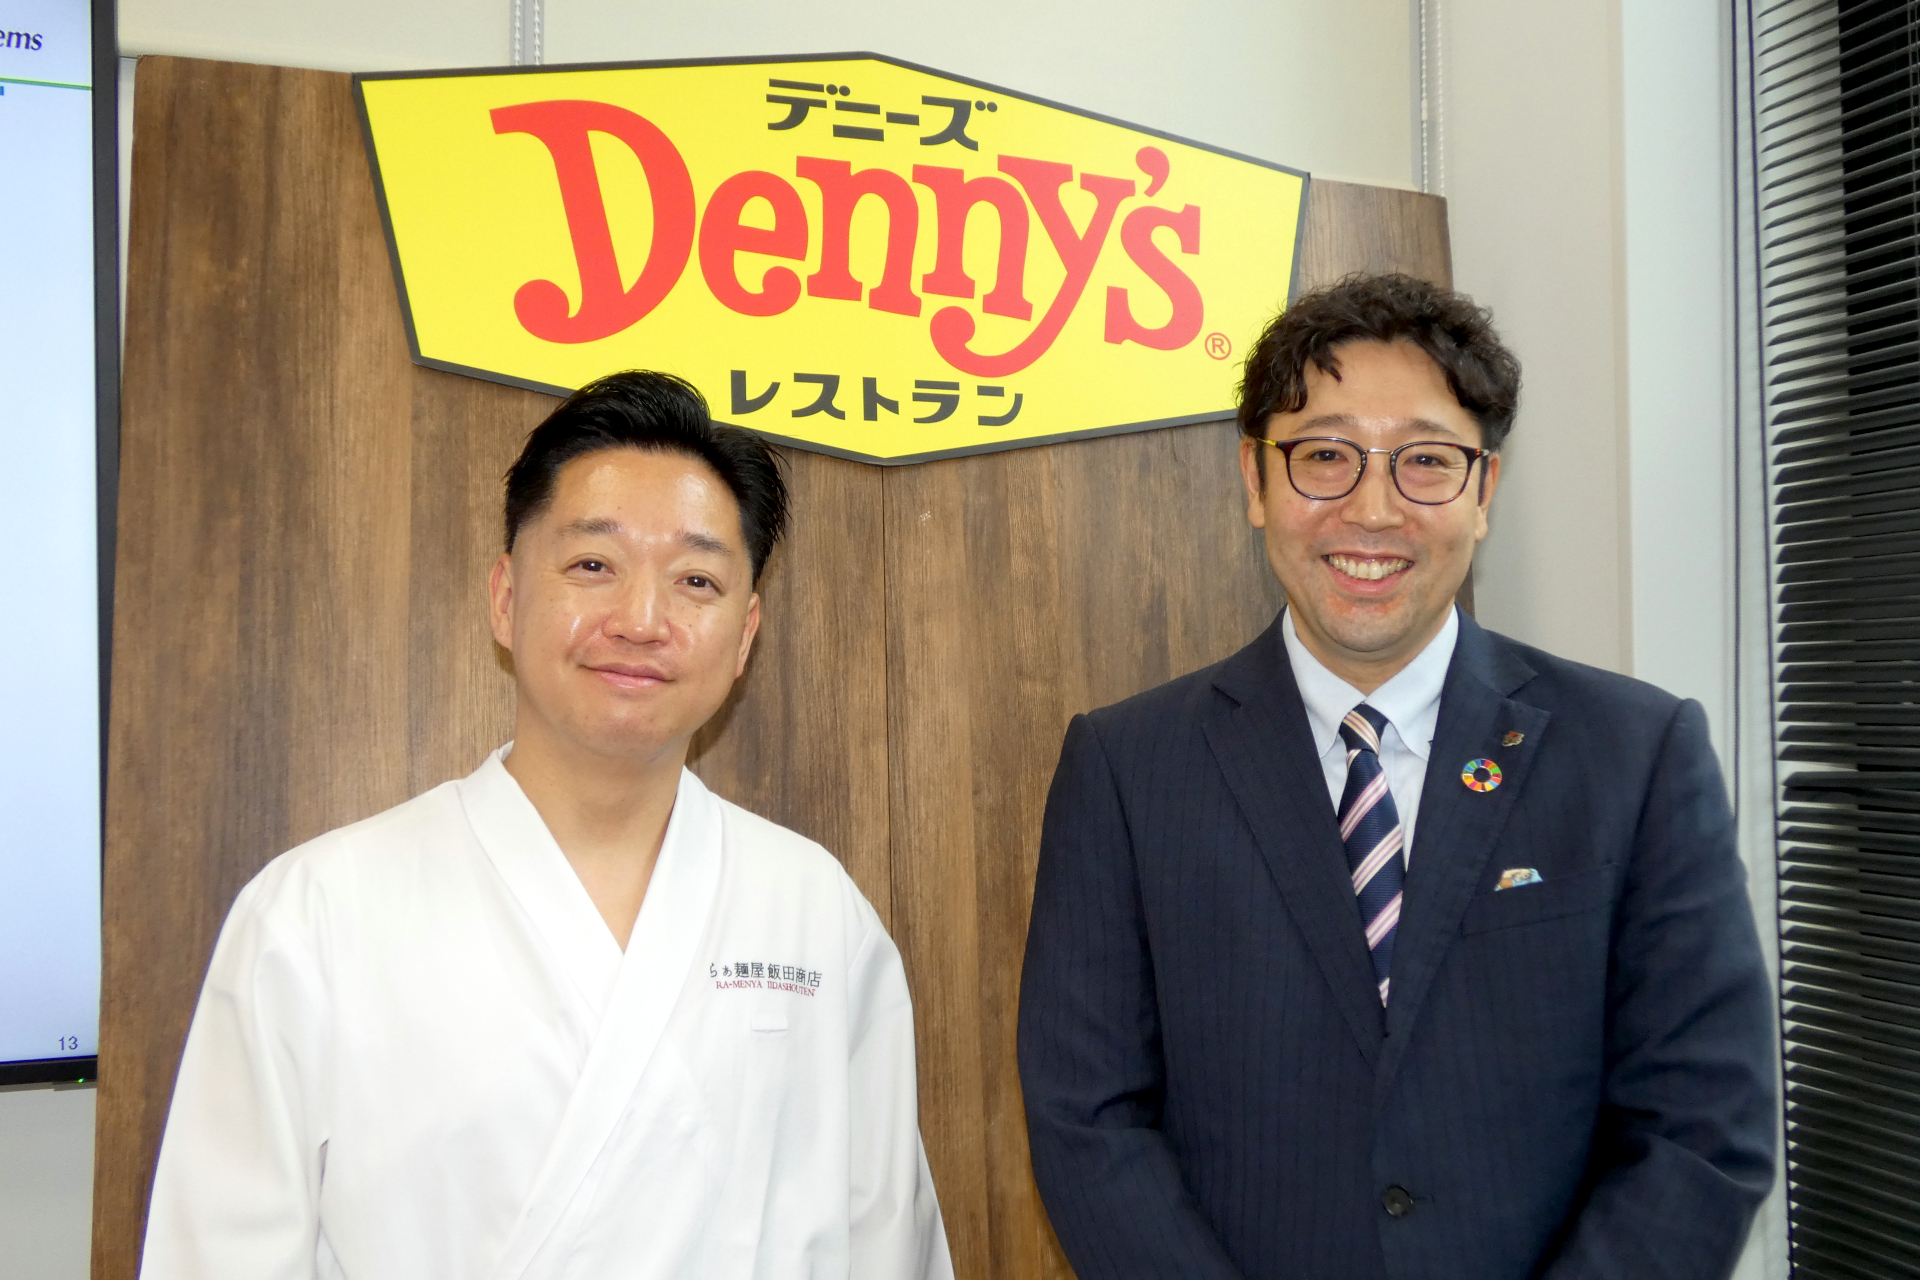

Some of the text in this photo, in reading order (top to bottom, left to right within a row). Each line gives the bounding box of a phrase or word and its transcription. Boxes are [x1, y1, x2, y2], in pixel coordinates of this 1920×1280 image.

[766, 78, 998, 152] デニーズ
[490, 99, 1205, 378] Denny's
[730, 369, 1023, 427] レストラン
[716, 980, 763, 989] RA-MENYA
[58, 1035, 78, 1051] 13
